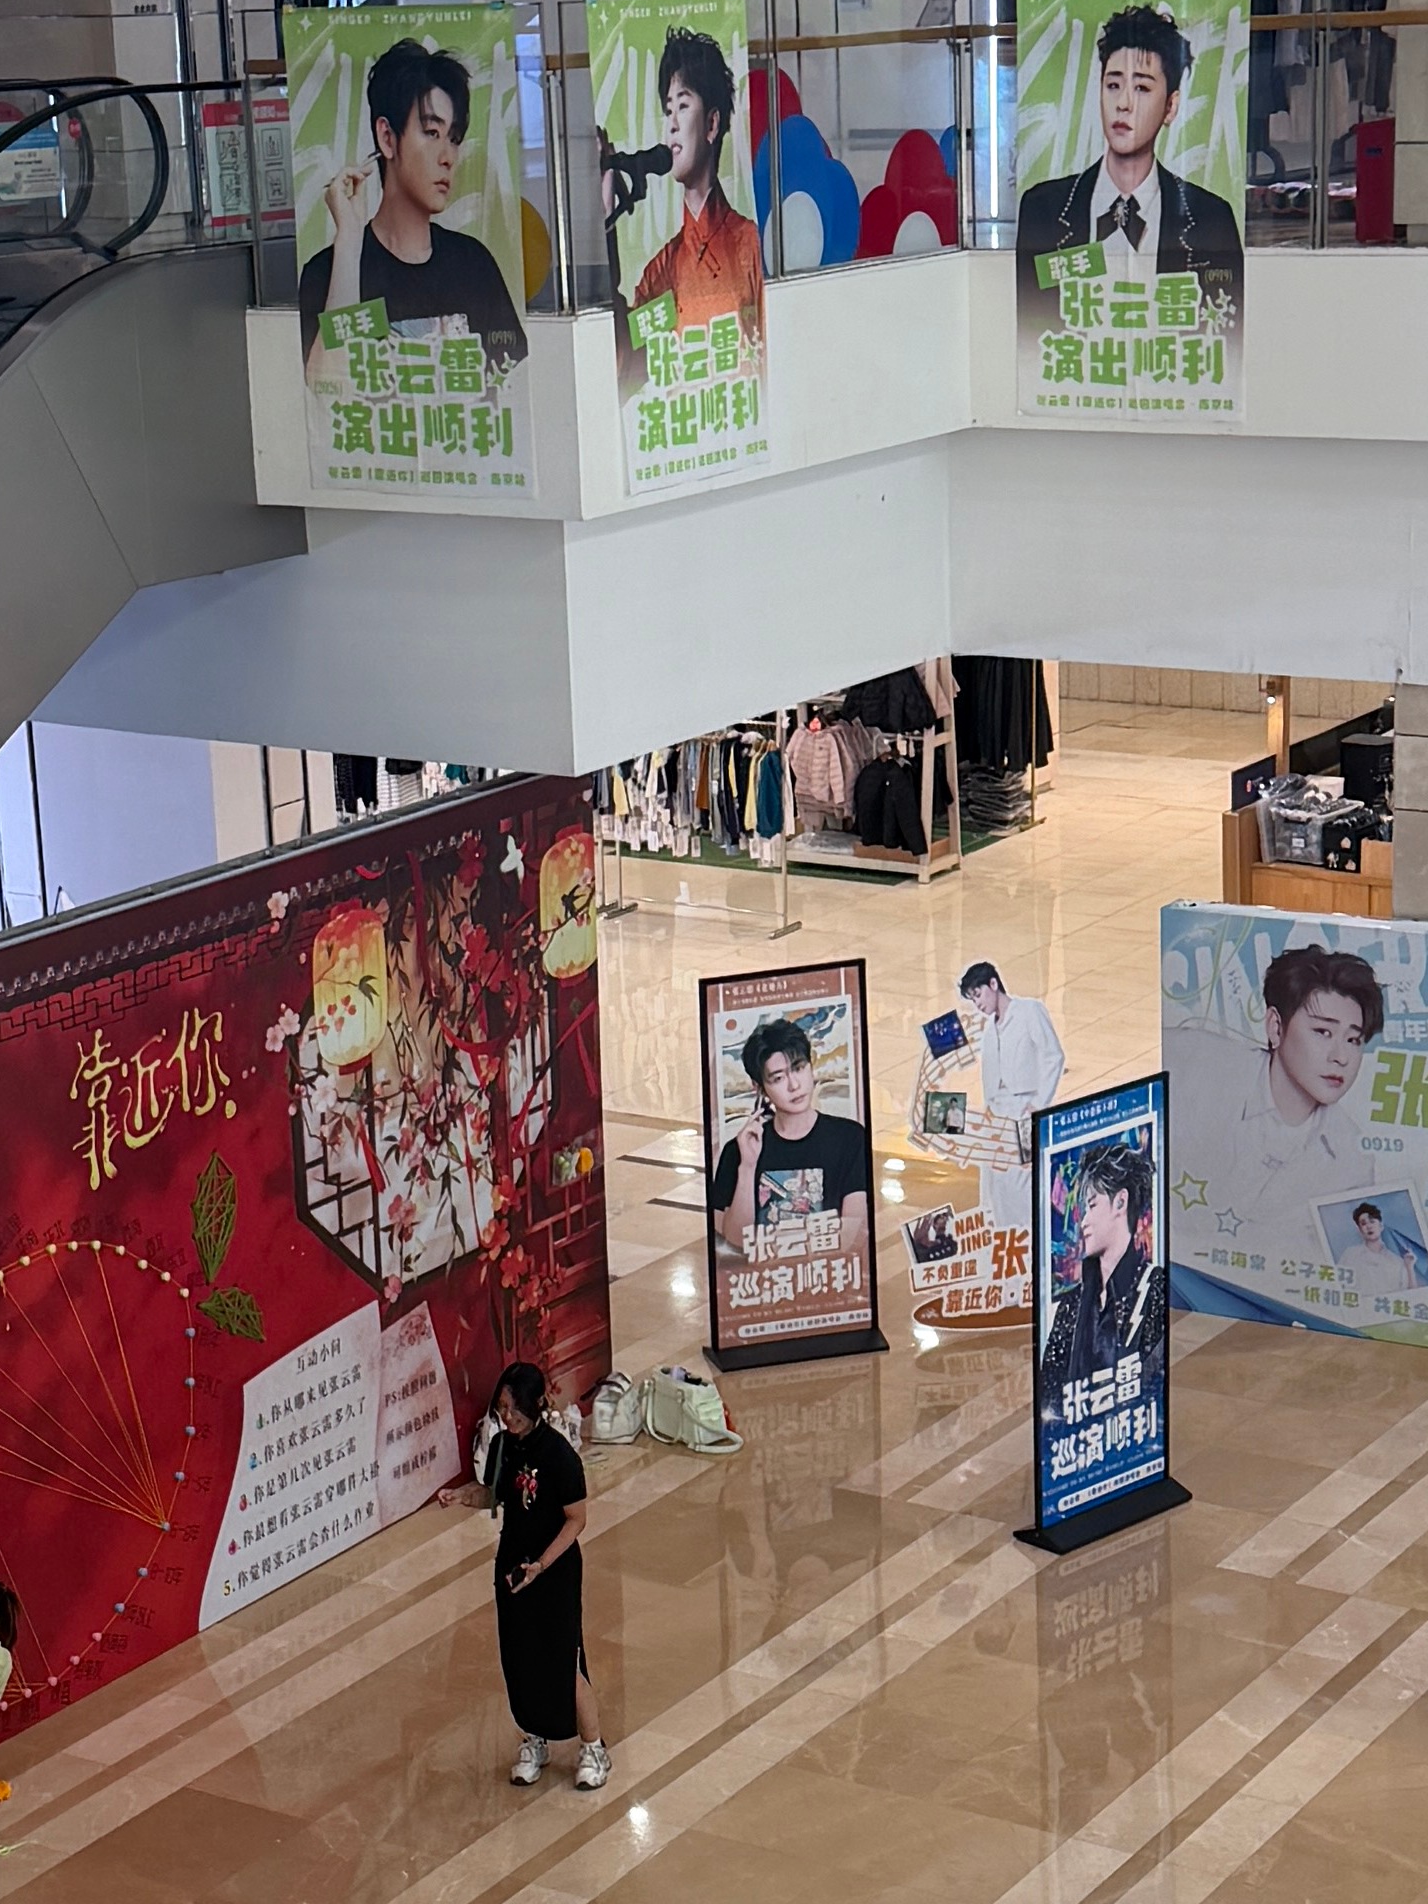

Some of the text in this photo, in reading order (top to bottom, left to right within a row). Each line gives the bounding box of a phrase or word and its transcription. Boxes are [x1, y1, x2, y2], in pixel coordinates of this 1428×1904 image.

[1048, 250, 1092, 281] 歌手
[332, 307, 375, 341] 歌手
[636, 301, 668, 339] 歌手
[1062, 275, 1199, 329] 张云雷
[348, 338, 484, 394] 张云雷
[647, 315, 740, 388] 张云雷
[1041, 334, 1224, 387] 演出顺利
[330, 399, 513, 458] 演出顺利
[637, 377, 760, 453] 演出顺利
[70, 1007, 238, 1191] 靠近你
[1360, 1136, 1405, 1153] 0919
[742, 1208, 841, 1264] 张云雷
[954, 1210, 985, 1236] NAN
[960, 1230, 992, 1256] JING
[728, 1253, 863, 1310] 巡演顺利
[296, 1338, 342, 1375] 互动小问
[1062, 1351, 1143, 1425] 张云雷
[1050, 1401, 1157, 1481] 巡演顺利
